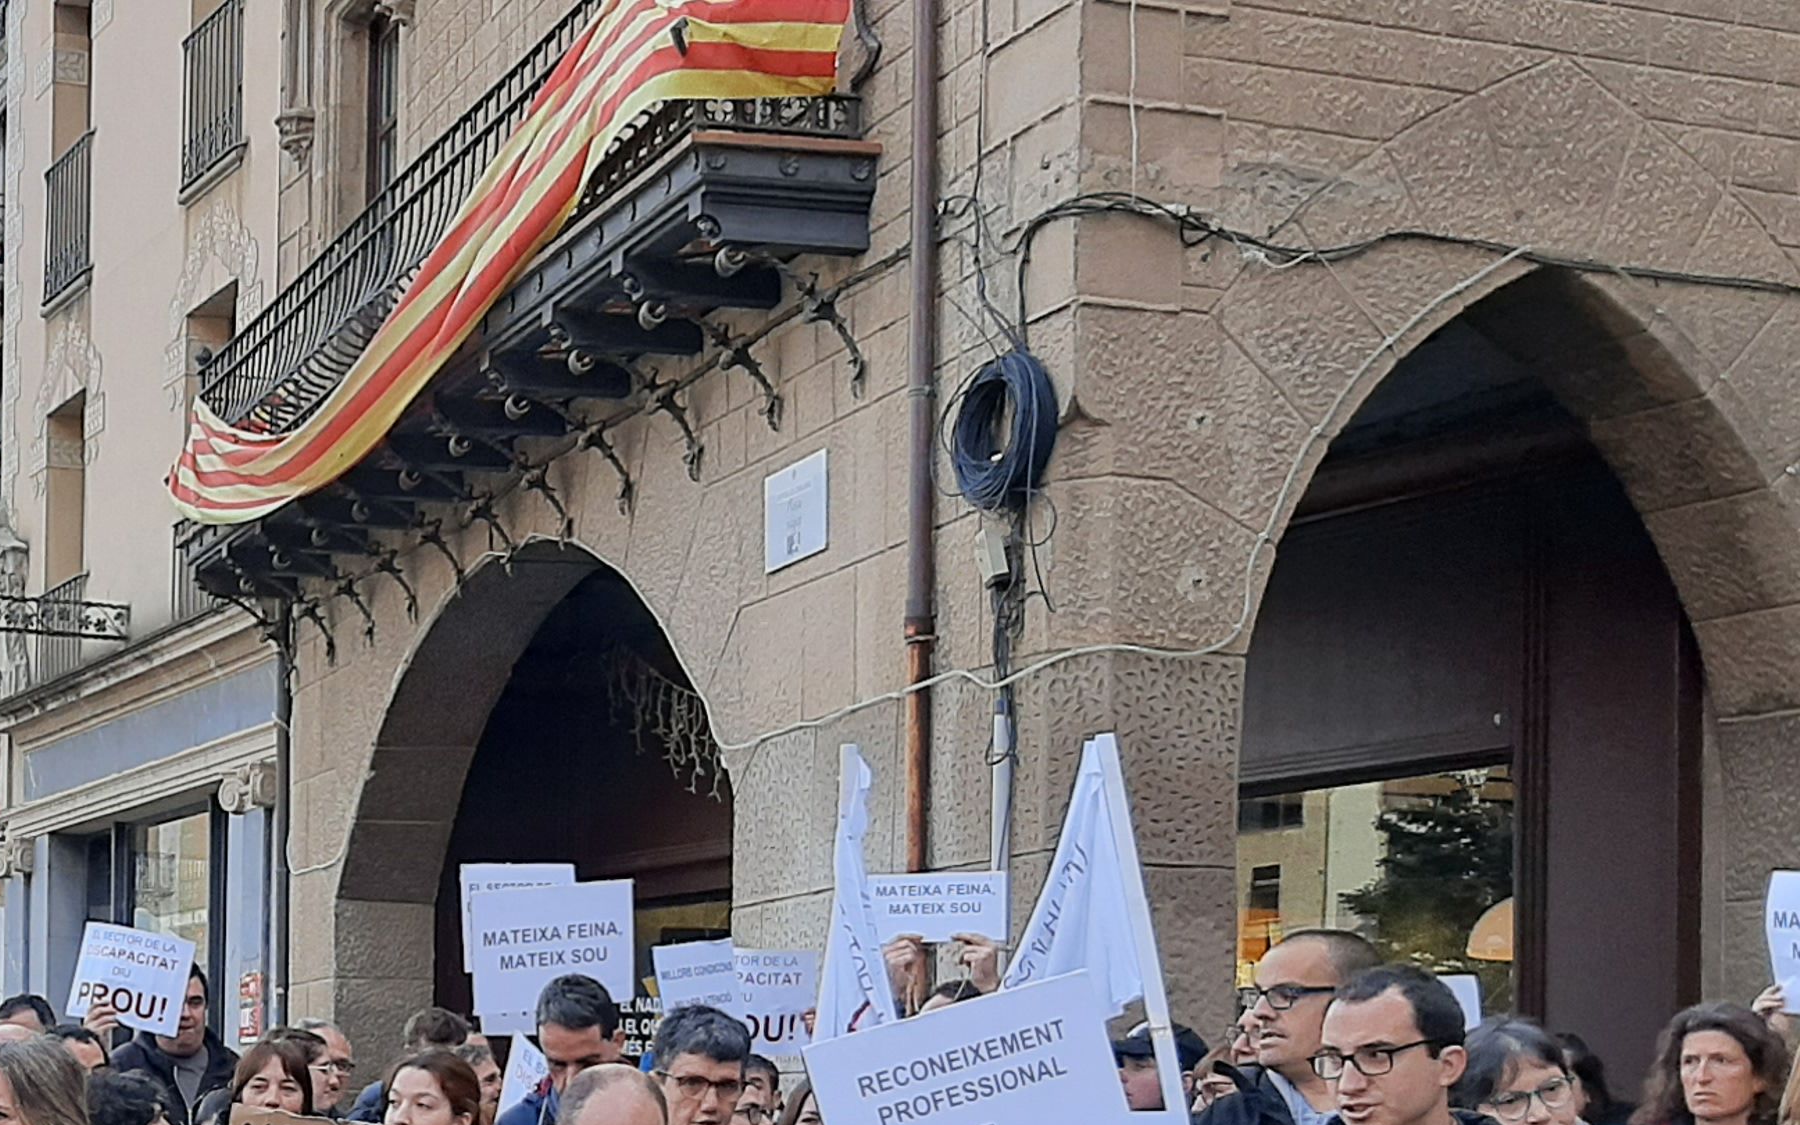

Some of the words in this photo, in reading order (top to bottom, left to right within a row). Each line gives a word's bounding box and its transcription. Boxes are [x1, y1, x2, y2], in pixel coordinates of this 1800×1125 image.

[875, 885, 942, 897] MATEIXA
[888, 902, 945, 915] MATEIX
[949, 901, 982, 914] SOU
[482, 926, 562, 948] MATEIXA
[499, 950, 566, 971] MATEIX
[571, 946, 608, 965] SOU
[763, 954, 780, 967] DE
[783, 954, 798, 967] LA
[76, 981, 169, 1023] PROU!
[856, 1018, 1066, 1098] RECONEIXEMENT
